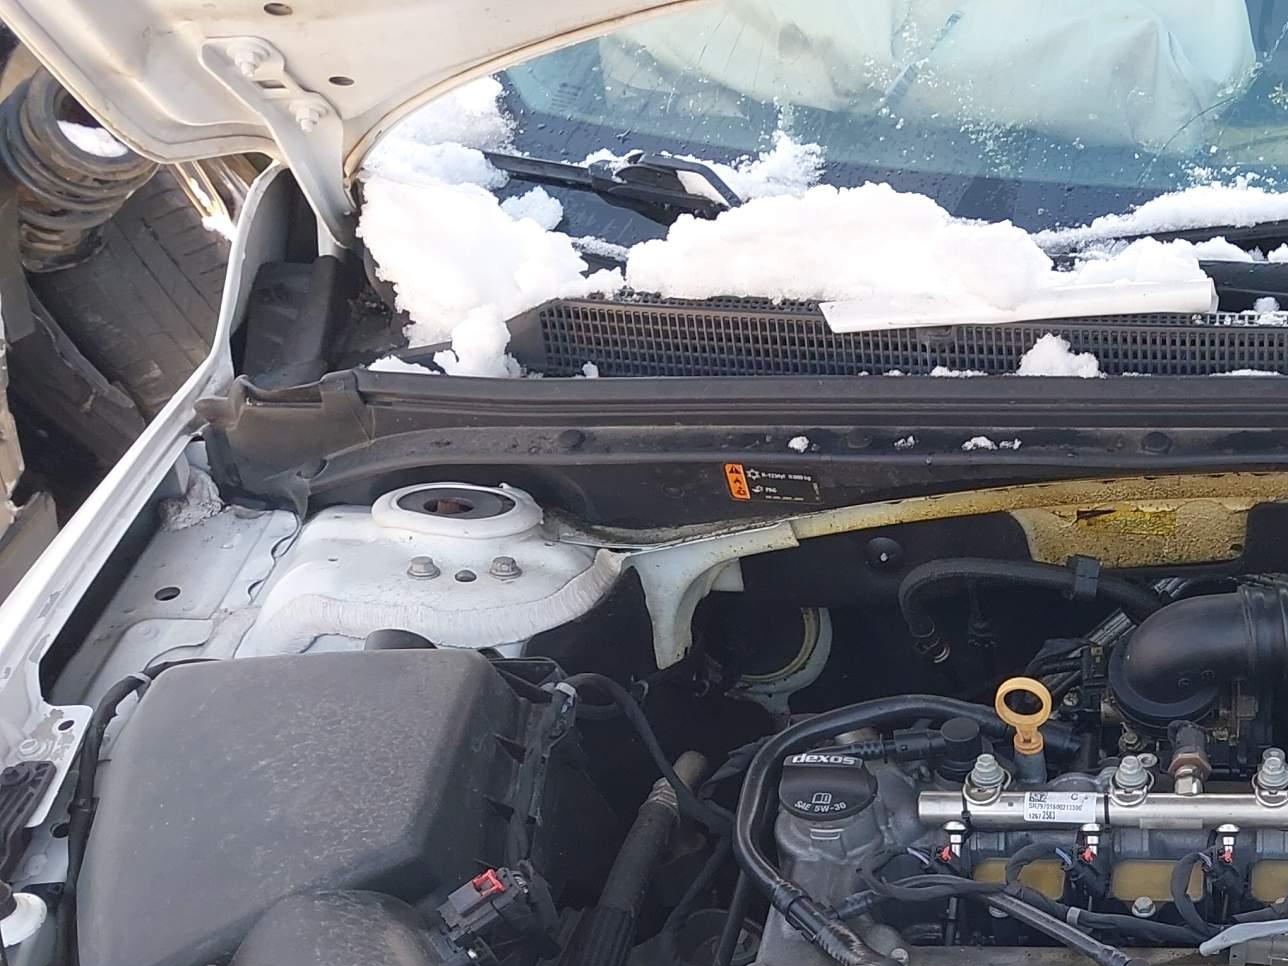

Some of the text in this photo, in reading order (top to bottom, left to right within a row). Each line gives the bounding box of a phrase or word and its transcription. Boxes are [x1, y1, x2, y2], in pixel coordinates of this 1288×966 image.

[792, 753, 855, 765] dexos
[795, 800, 847, 813] SAE 5W-30
